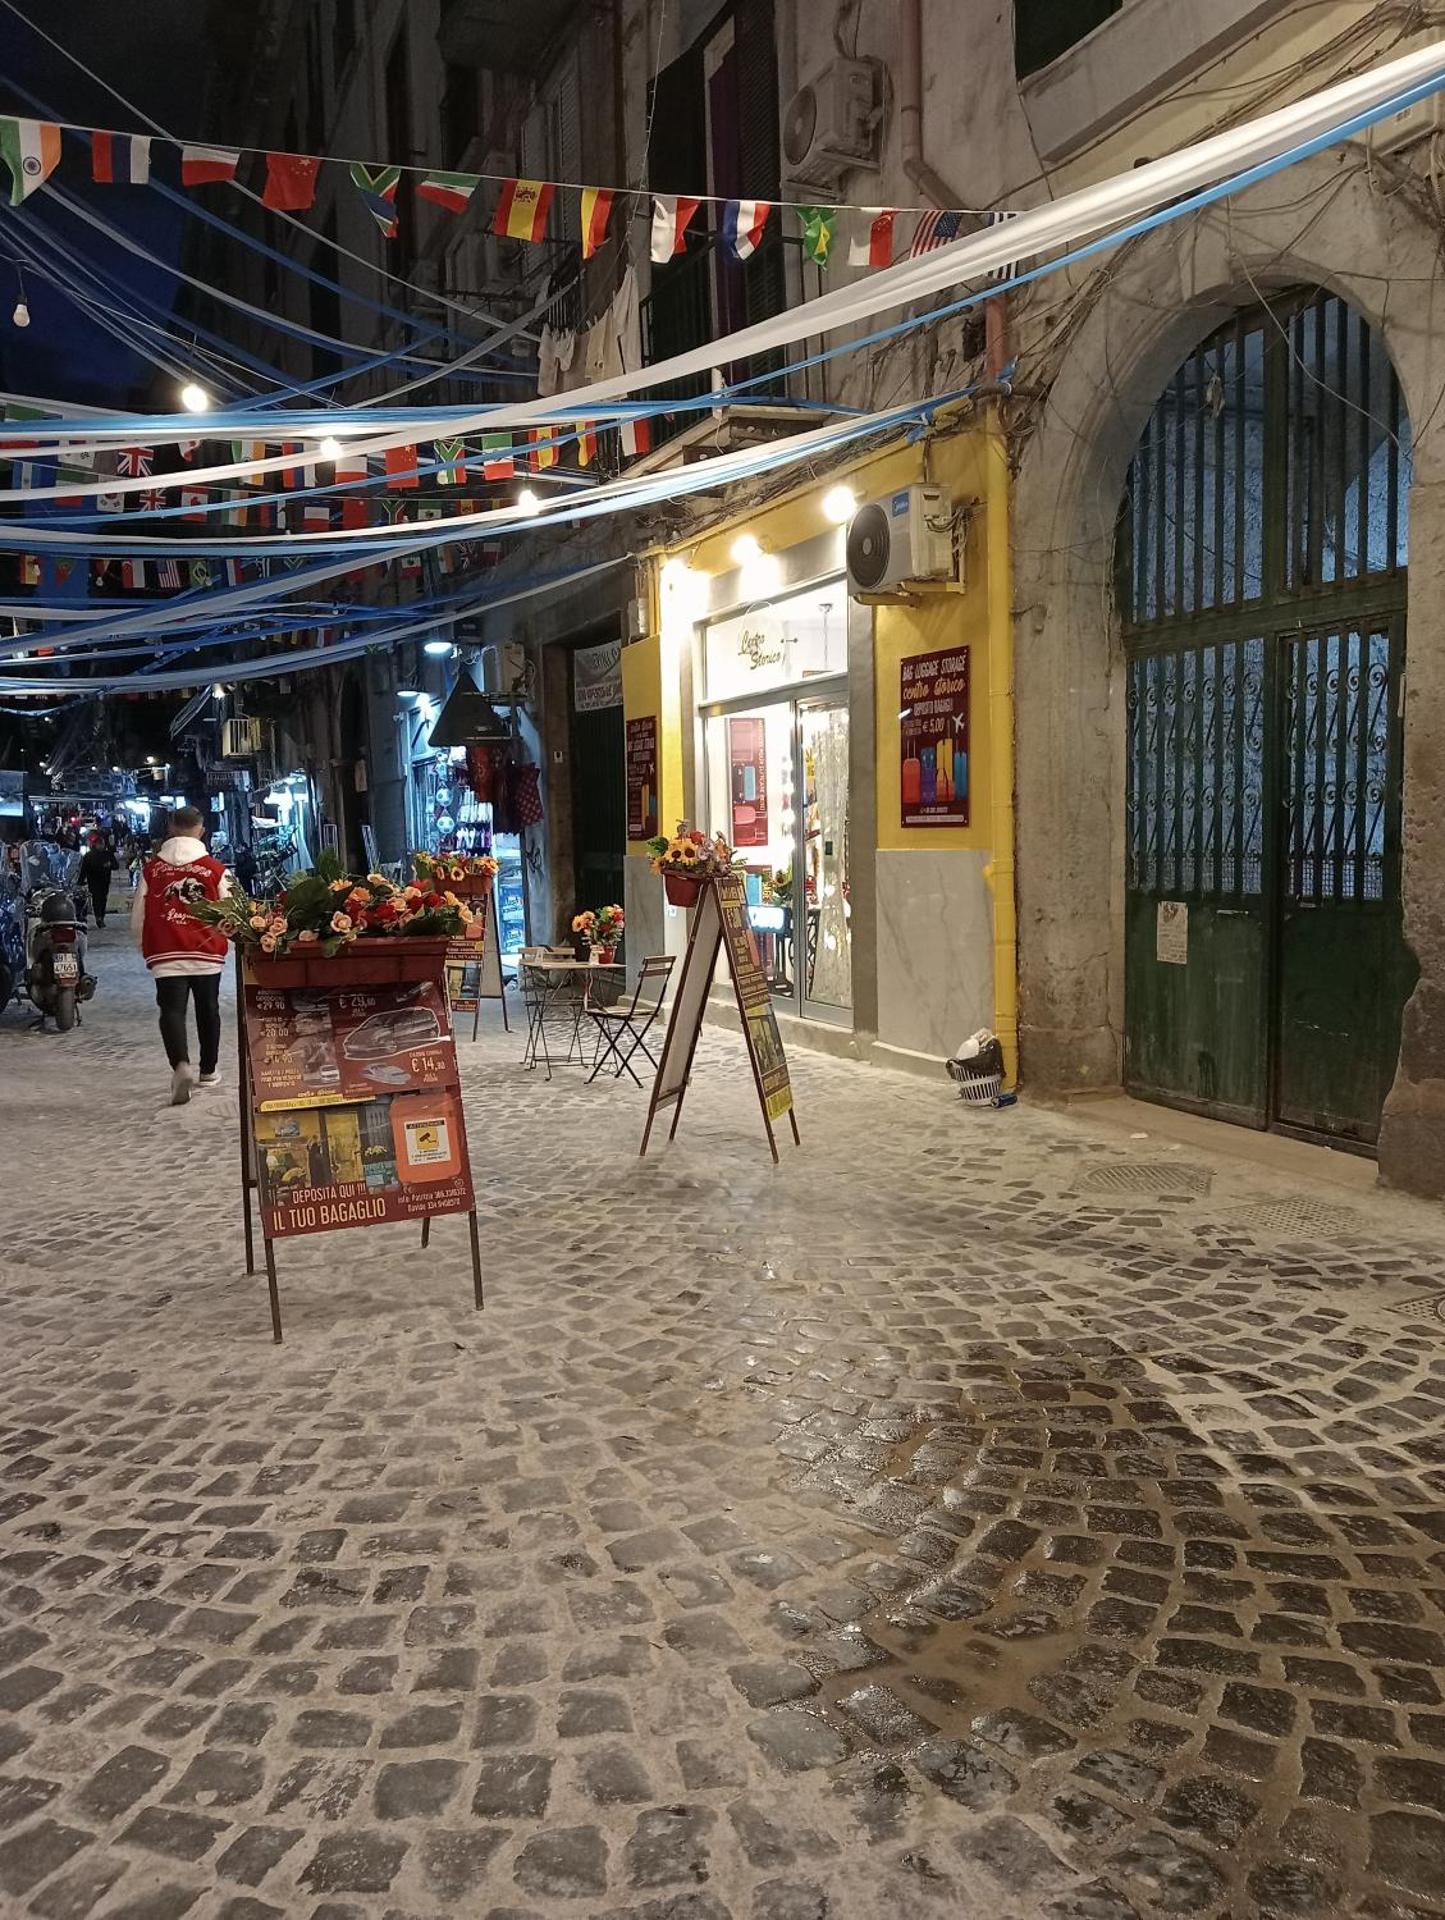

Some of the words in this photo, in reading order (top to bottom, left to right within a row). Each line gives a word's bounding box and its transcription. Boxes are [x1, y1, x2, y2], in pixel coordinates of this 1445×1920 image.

[941, 655, 966, 675] STORAGE
[292, 1186, 338, 1205] DEPOSITA
[339, 1183, 356, 1199] QUI
[273, 1210, 286, 1232] IL
[288, 1206, 317, 1229] TUO
[319, 1197, 387, 1225] BAGAGLIO
